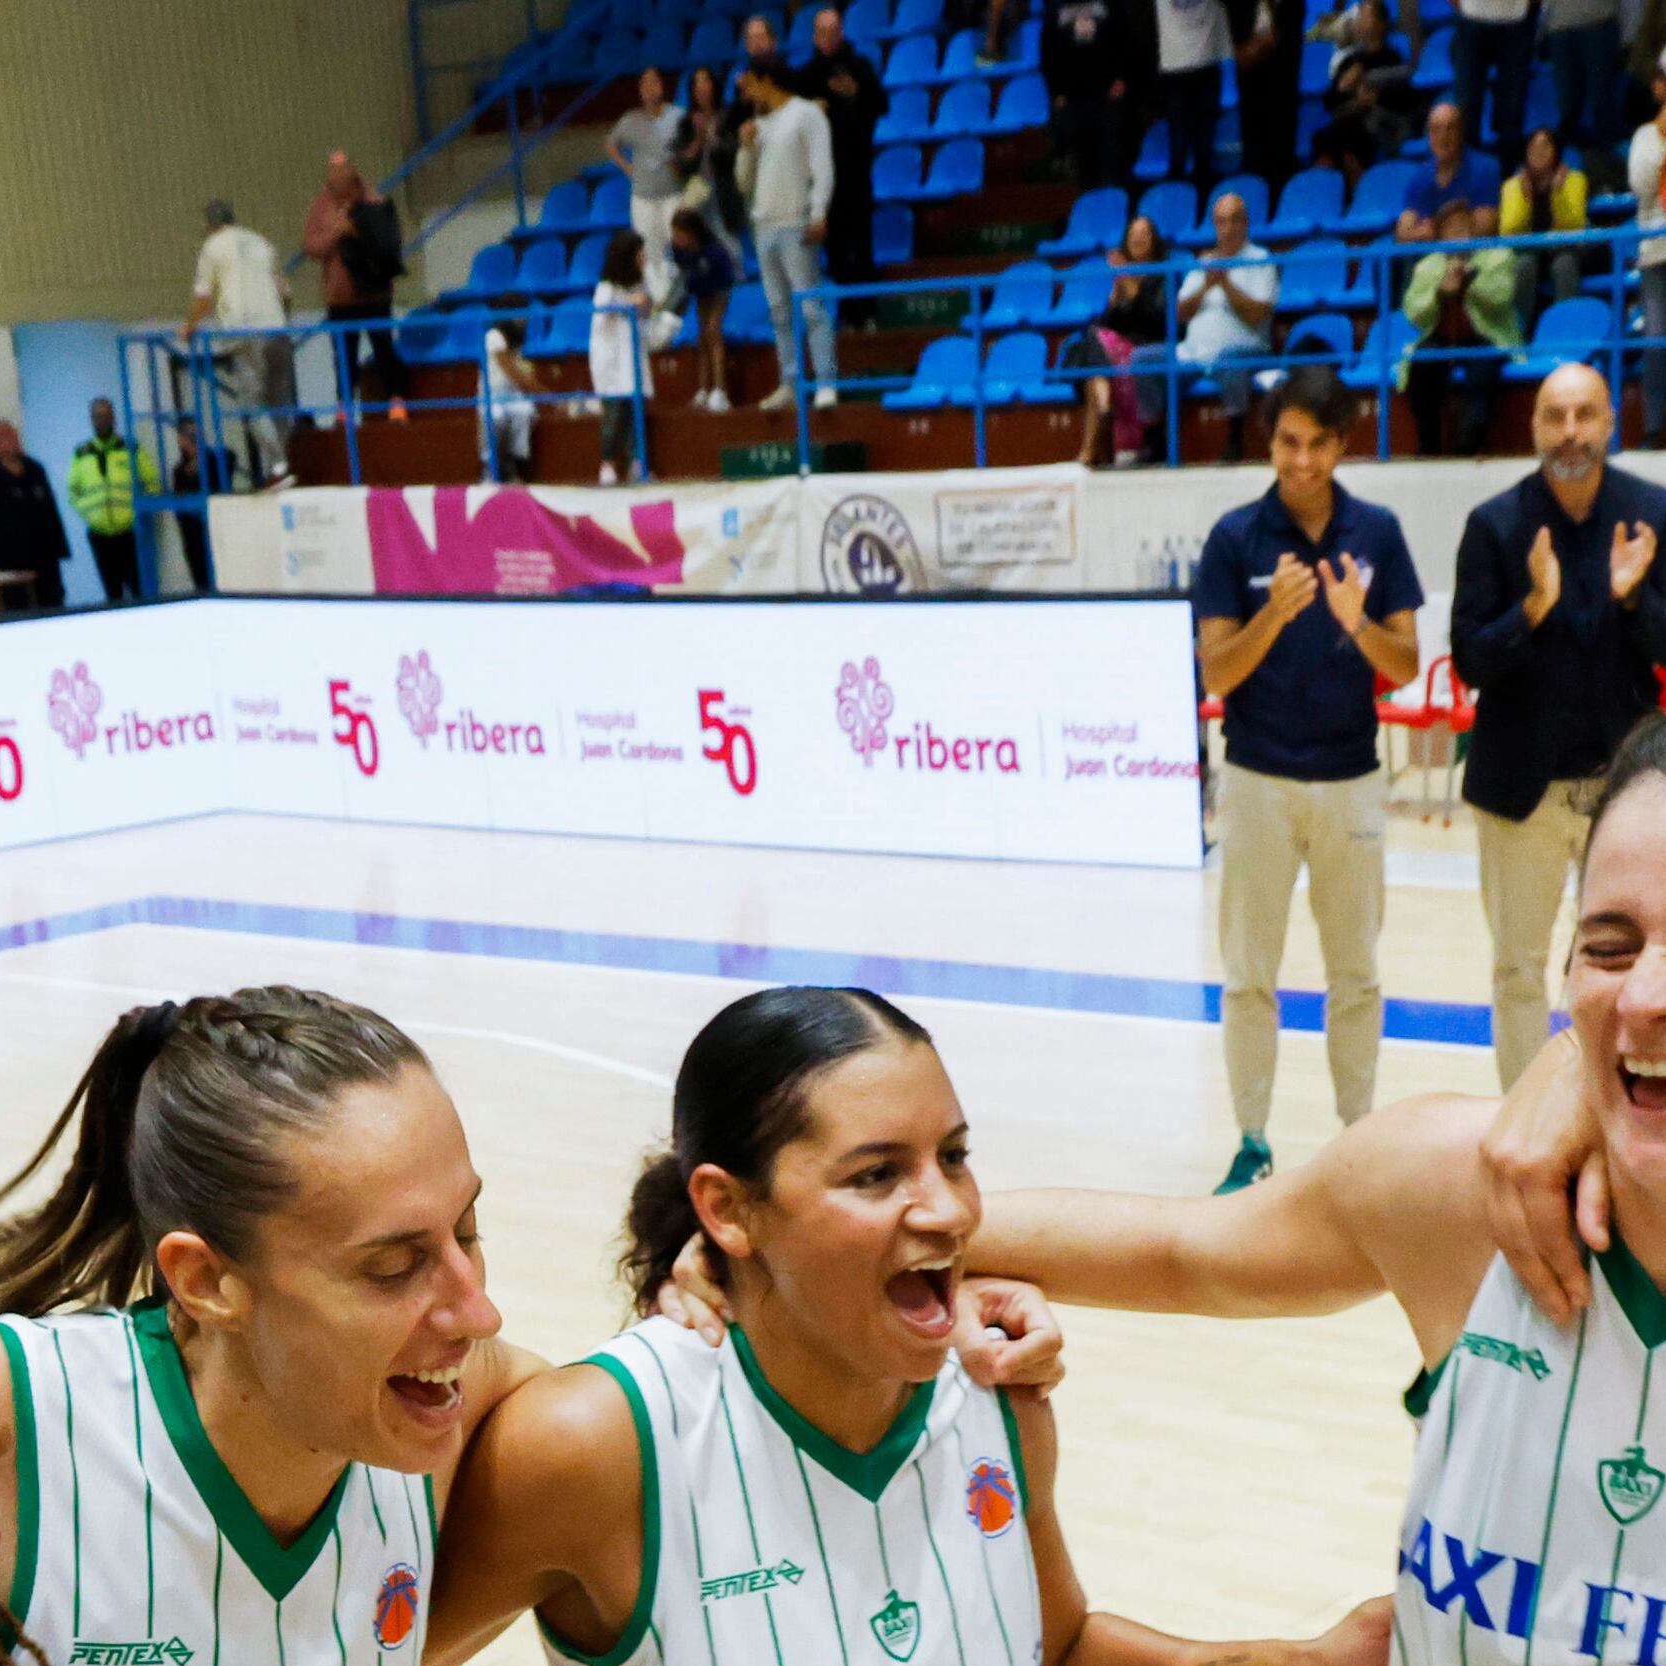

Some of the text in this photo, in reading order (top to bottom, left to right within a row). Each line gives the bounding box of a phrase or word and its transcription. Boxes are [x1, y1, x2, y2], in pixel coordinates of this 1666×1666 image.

[105, 709, 213, 757] ribera
[328, 679, 378, 777] 50
[445, 707, 546, 756] ribera
[580, 740, 613, 763] Juan
[697, 688, 758, 797] 50
[895, 721, 1022, 773] ribera
[1062, 720, 1138, 747] Hospital
[1064, 754, 1109, 781] Juan
[700, 1568, 780, 1602] PENTEX
[1399, 1515, 1544, 1641] AXI
[69, 1641, 165, 1666] PENTEX
